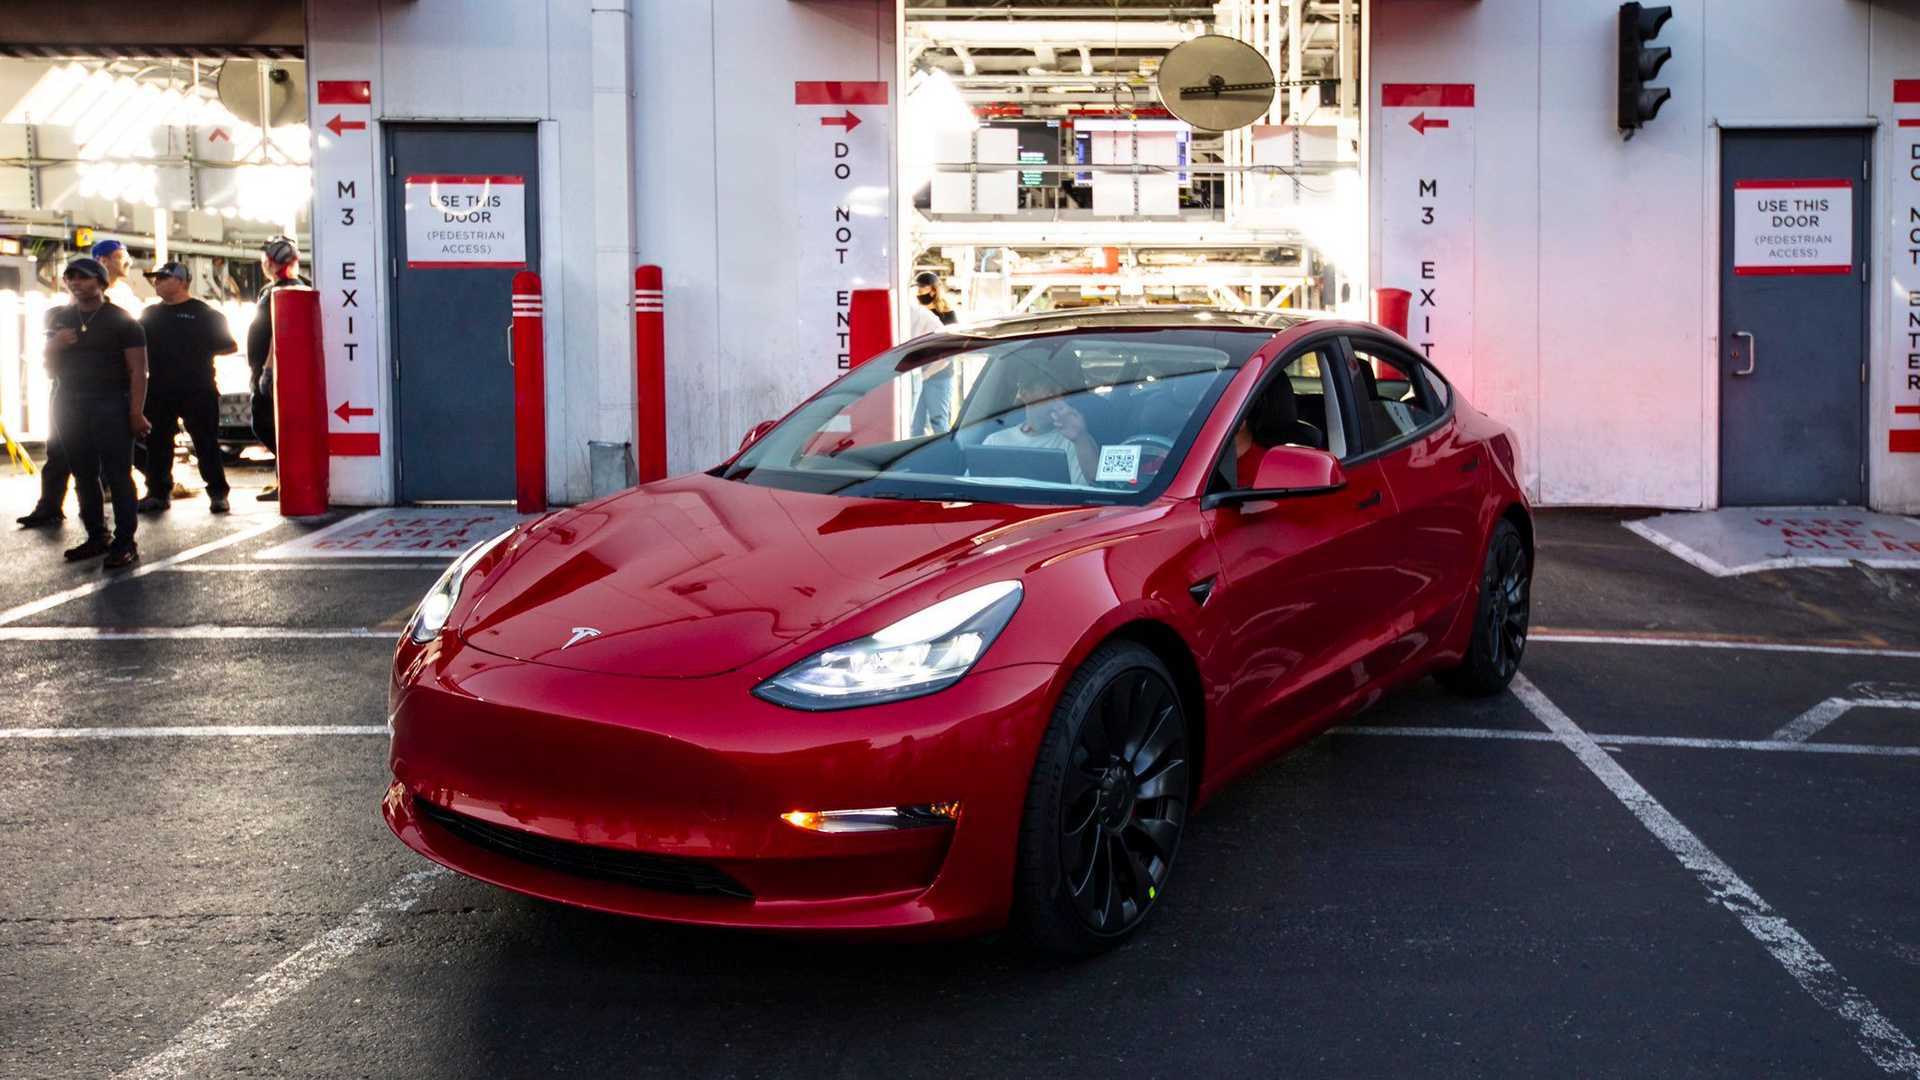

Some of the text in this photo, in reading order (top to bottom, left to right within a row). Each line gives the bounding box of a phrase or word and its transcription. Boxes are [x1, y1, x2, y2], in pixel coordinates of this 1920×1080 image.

[466, 195, 501, 208] THIS
[1757, 199, 1829, 212] USE THIS
[444, 211, 491, 223] DOOR
[1772, 215, 1819, 228] DOOR
[427, 231, 505, 241] (PEDESTRIAN
[1755, 235, 1832, 246] (PEDESTRIAN
[442, 244, 492, 255] ACCESS)
[1769, 248, 1818, 258] ACCESS)
[835, 142, 851, 377] DO NOT ENTE
[337, 181, 358, 361] M3 EXIT
[1419, 179, 1437, 358] M3 EXIT
[1908, 291, 1920, 390] ENTER
